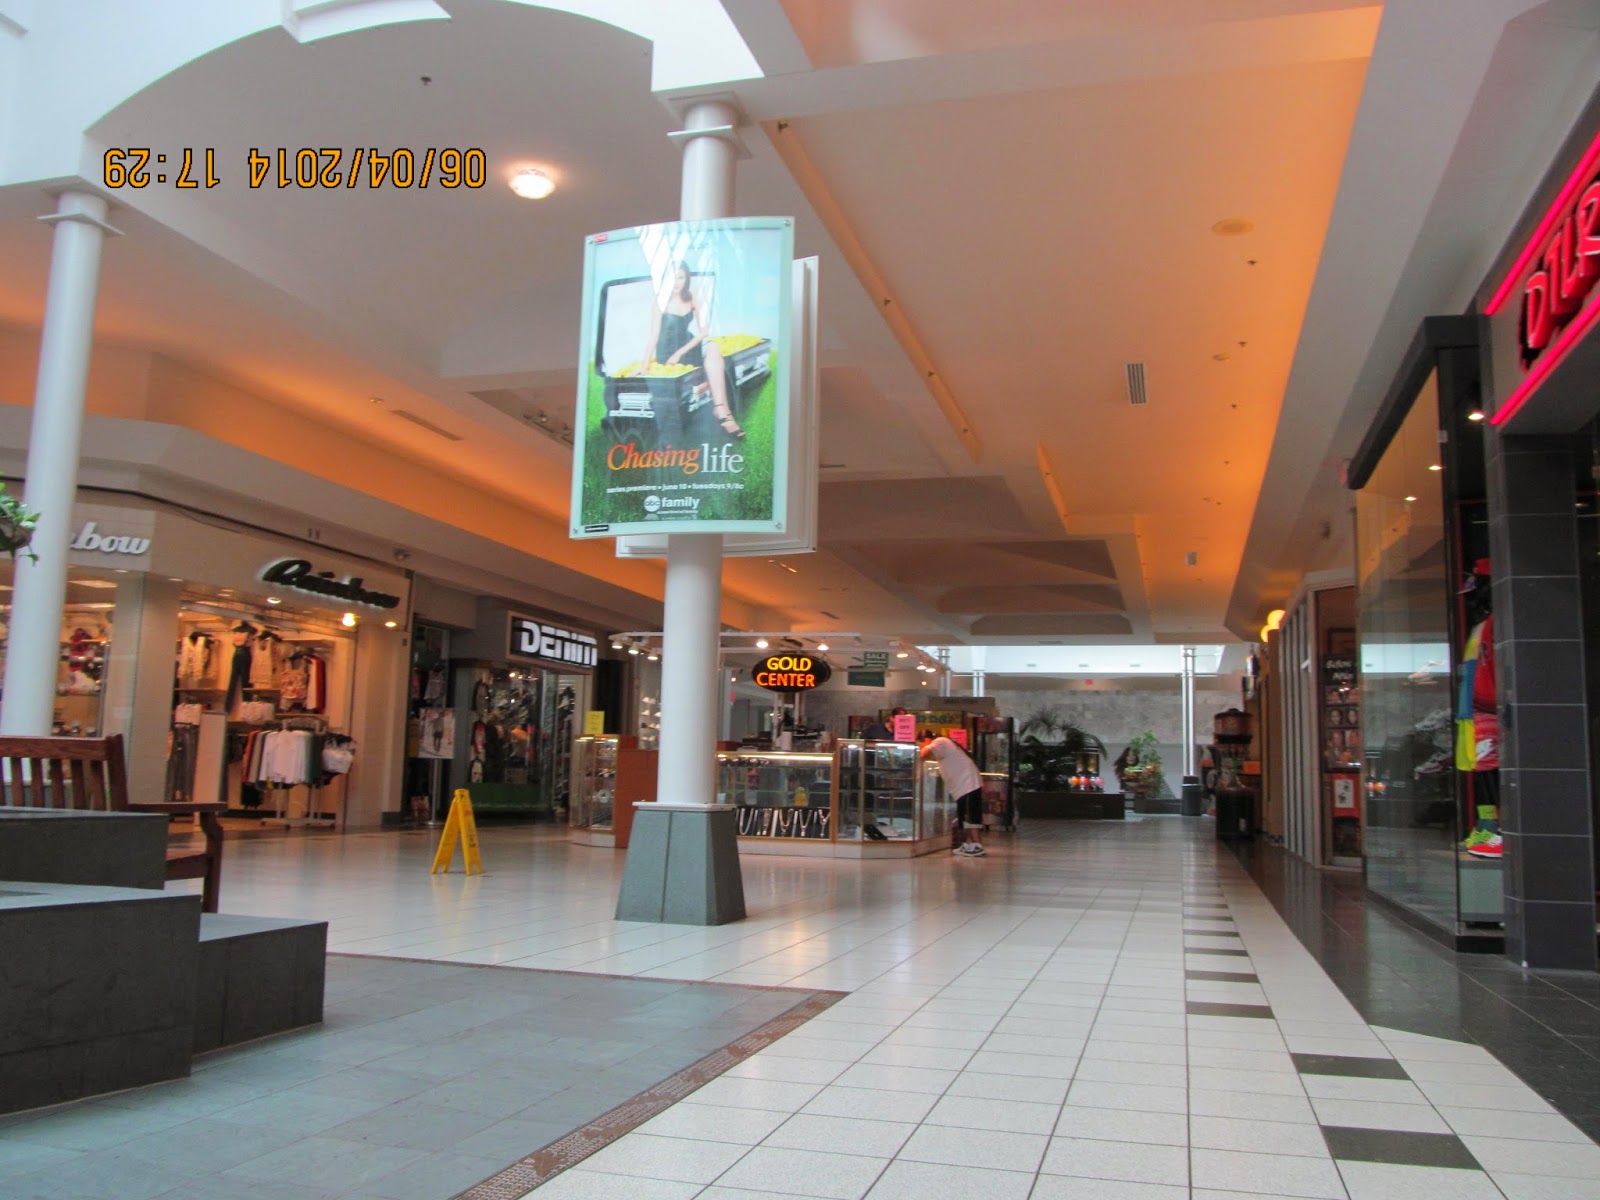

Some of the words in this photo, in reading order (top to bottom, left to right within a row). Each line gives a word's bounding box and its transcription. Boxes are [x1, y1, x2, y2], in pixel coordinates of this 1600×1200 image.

[606, 441, 700, 475] Chasing
[701, 442, 744, 473] life
[662, 496, 700, 509] family
[766, 656, 812, 671] GOLD
[756, 672, 815, 687] CENTER
